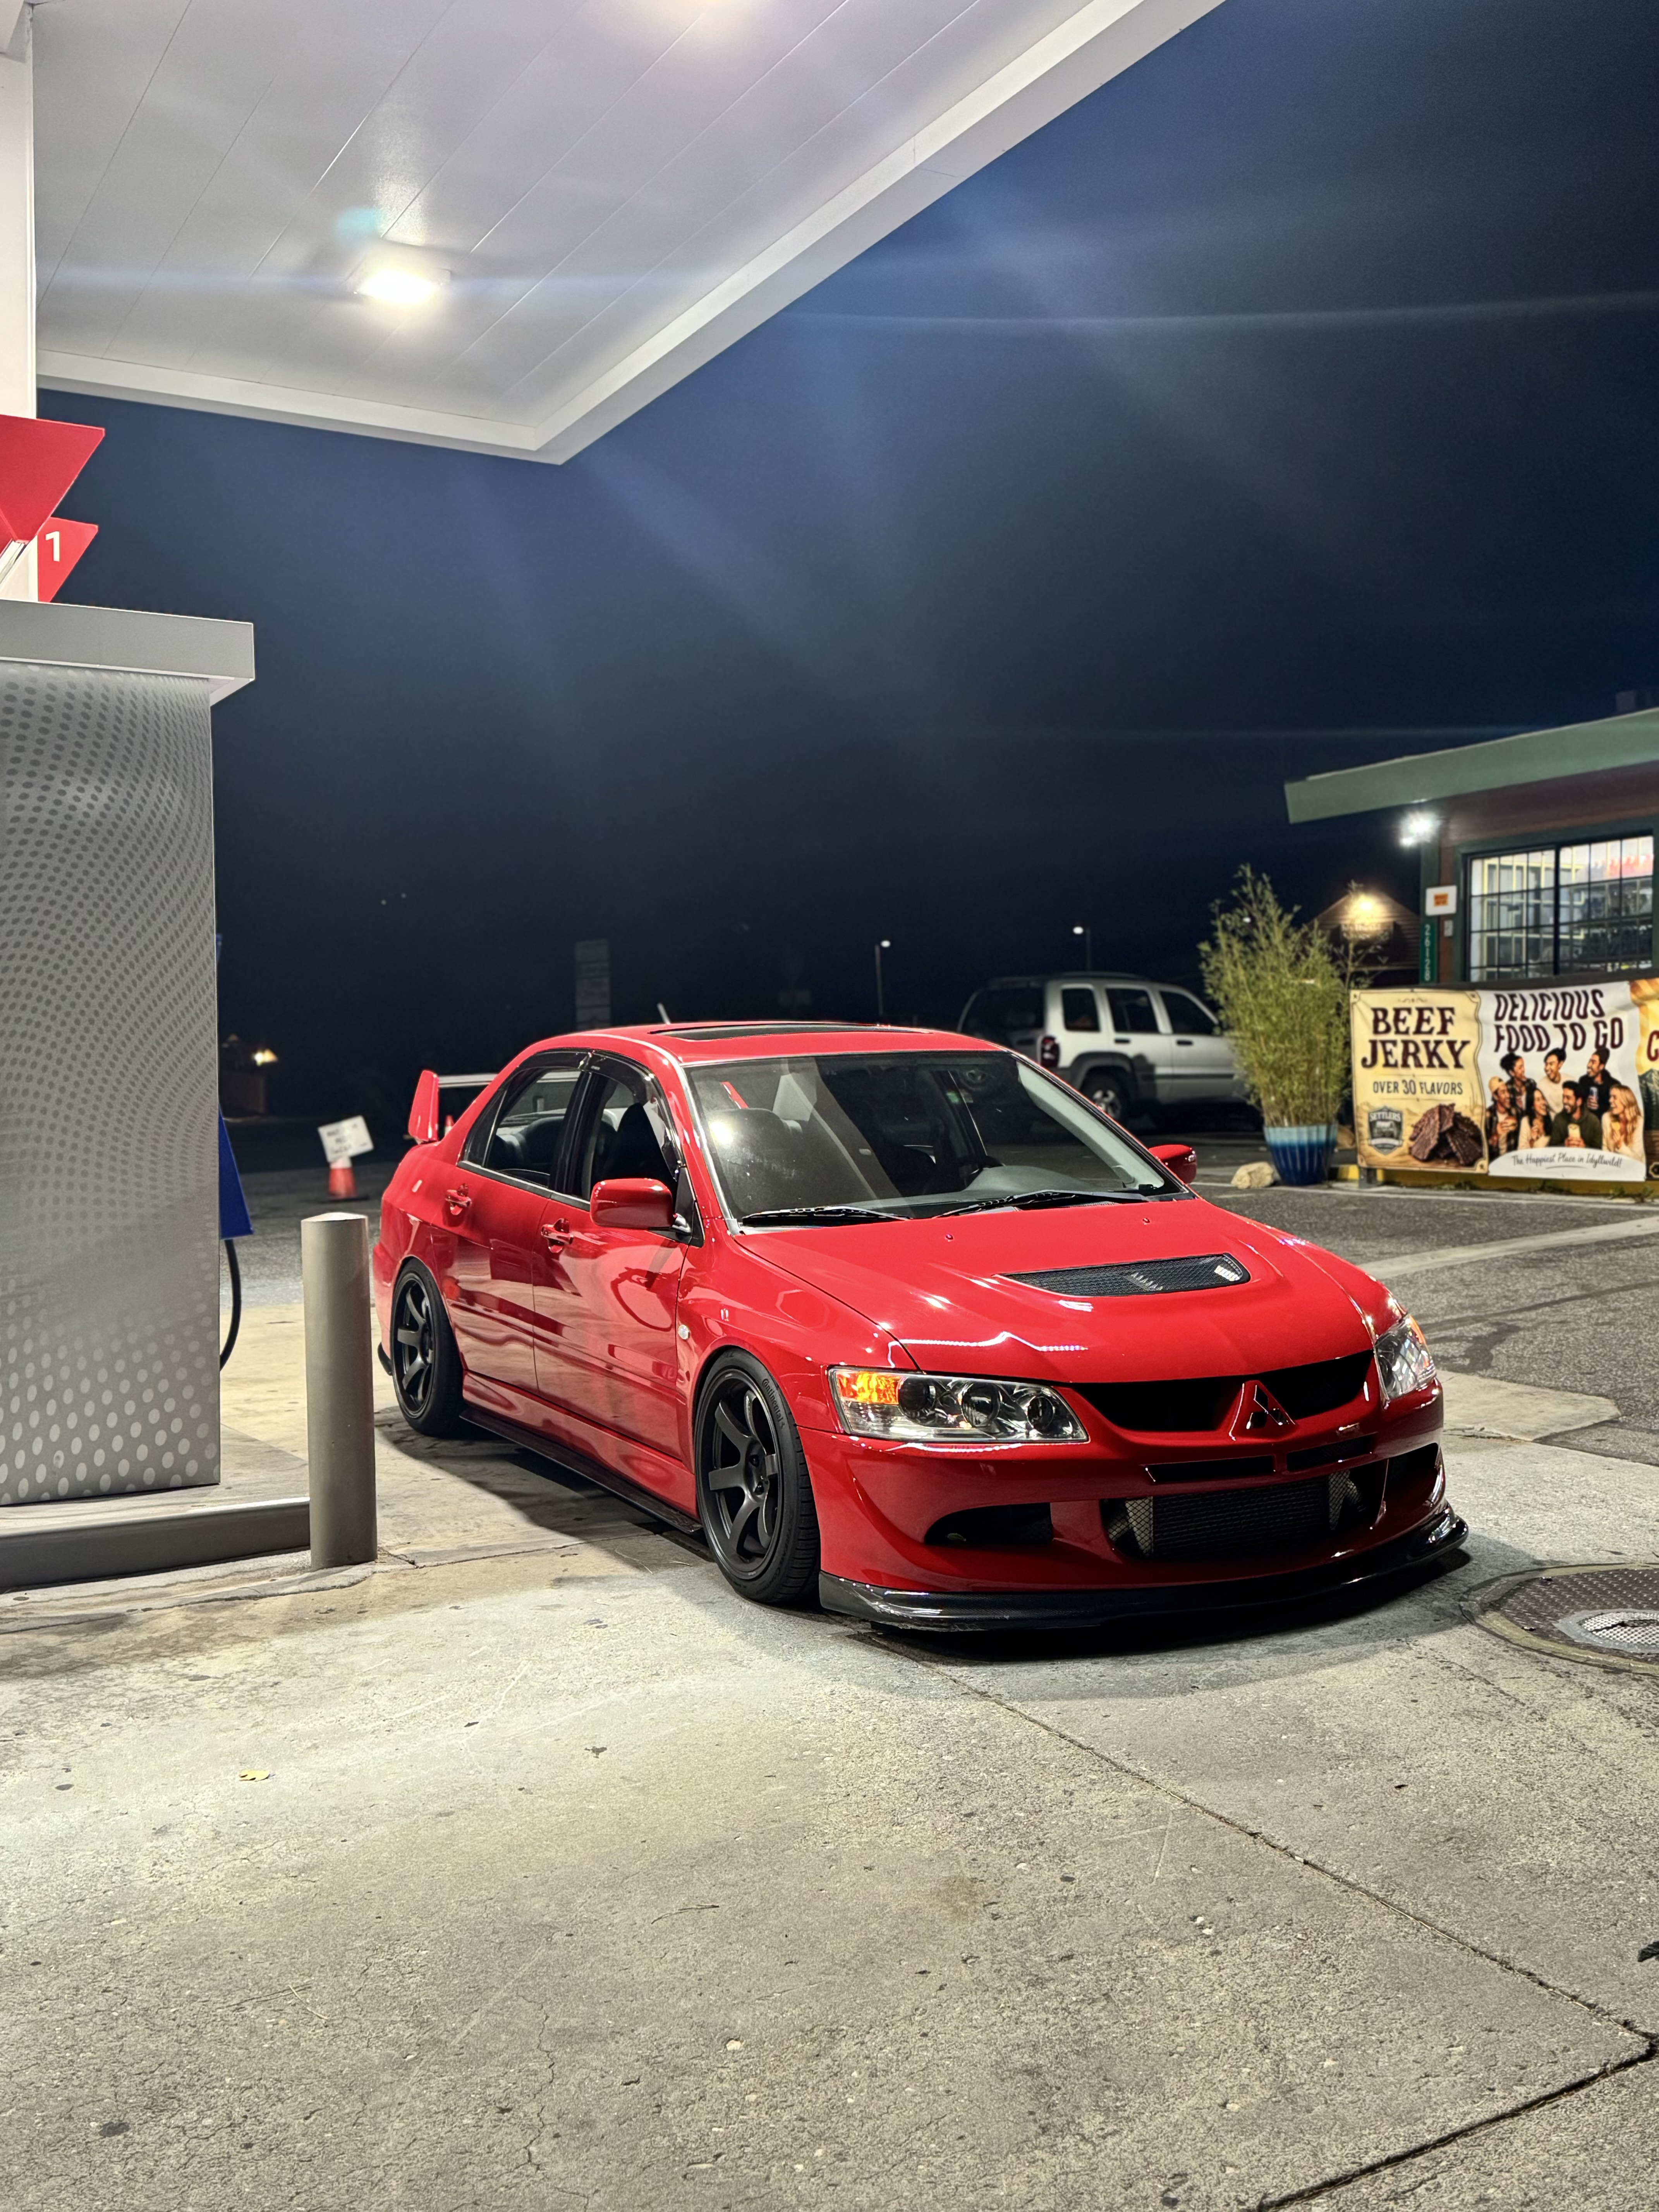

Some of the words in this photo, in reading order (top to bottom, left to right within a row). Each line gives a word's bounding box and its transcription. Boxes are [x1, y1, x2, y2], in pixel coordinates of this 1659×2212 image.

[45, 531, 60, 562] 1
[1494, 989, 1604, 1021] DELICIOUS
[1371, 1007, 1455, 1036] BEEF
[1494, 1024, 1550, 1052] FOOD
[1554, 1021, 1587, 1051] TO
[1594, 1017, 1624, 1049] GO
[1362, 1040, 1470, 1069] JERKY
[1373, 1081, 1399, 1094] OVER
[1402, 1080, 1416, 1095] 30
[1420, 1081, 1463, 1095] FLAVORS
[1369, 1111, 1401, 1122] SETTLERS
[1511, 1155, 1523, 1165] The
[1525, 1154, 1555, 1166] Happiest
[1558, 1154, 1576, 1163] Place
[1586, 1154, 1622, 1168] Idyllwild!
[762, 1379, 783, 1422] Continental
